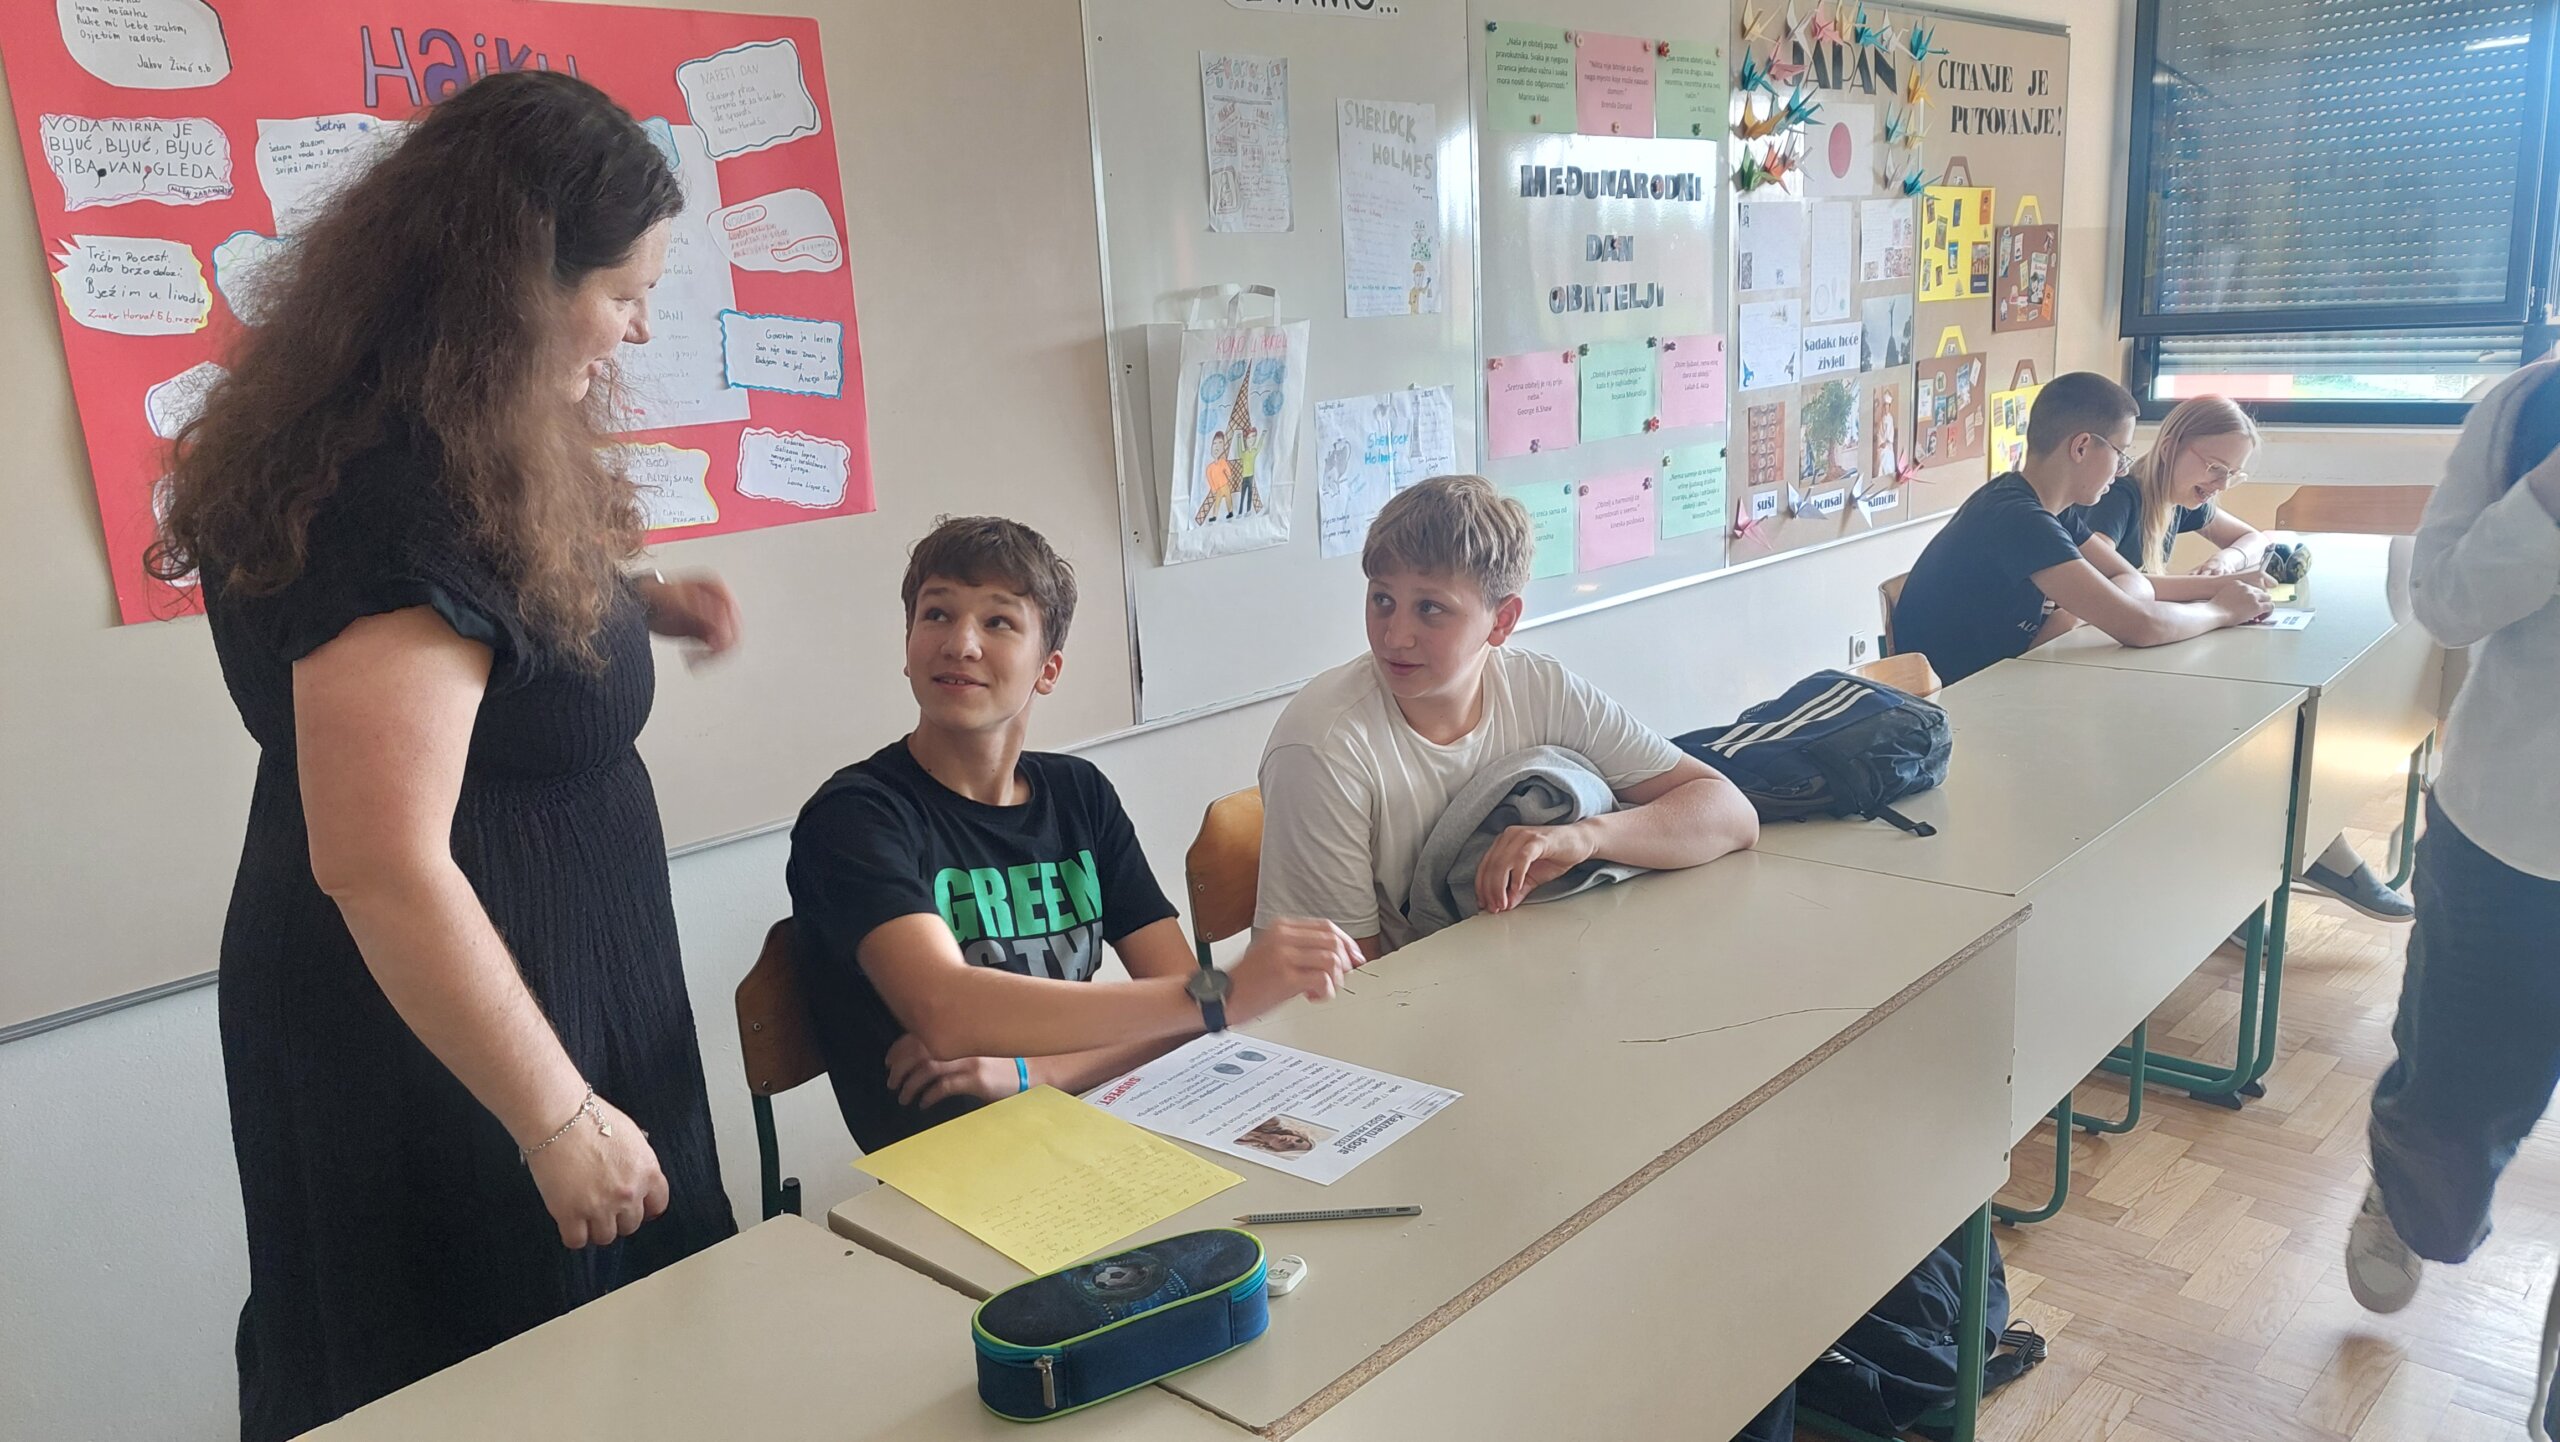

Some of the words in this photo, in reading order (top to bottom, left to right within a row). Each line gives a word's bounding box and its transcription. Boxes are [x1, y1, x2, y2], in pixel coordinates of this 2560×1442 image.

[2028, 70, 2049, 96] JE
[44, 114, 103, 132] VODA
[112, 121, 164, 132] MIRNA
[173, 123, 192, 138] JE
[314, 116, 346, 132] Šetnja
[1344, 100, 1416, 144] SHERLOCK
[1951, 105, 2062, 137] PUTOVANJE!
[52, 155, 99, 174] RIBA
[109, 161, 141, 174] VAN
[1372, 142, 1433, 180] HOLMES
[1520, 165, 1701, 201] MEĐUNARODNI
[86, 246, 121, 262] Trčim
[1586, 234, 1634, 262] DAN
[88, 262, 113, 273] Auto
[122, 265, 150, 276] brzo
[1549, 282, 1664, 314] OBITELJI
[1804, 337, 1836, 352] Sadako
[1838, 332, 1859, 347] hoće
[1818, 354, 1845, 370] živjeti
[1517, 407, 1534, 416] George
[1757, 495, 1775, 511] suši
[1814, 493, 1843, 510] bonsai
[934, 849, 1103, 944] GREEN
[1100, 1076, 1142, 1106] SUSPECT
[1360, 1097, 1382, 1109] godina
[1364, 1114, 1387, 1126] ADDY
[1364, 1114, 1405, 1137] Kazneni
[1336, 1137, 1370, 1155] dosje
